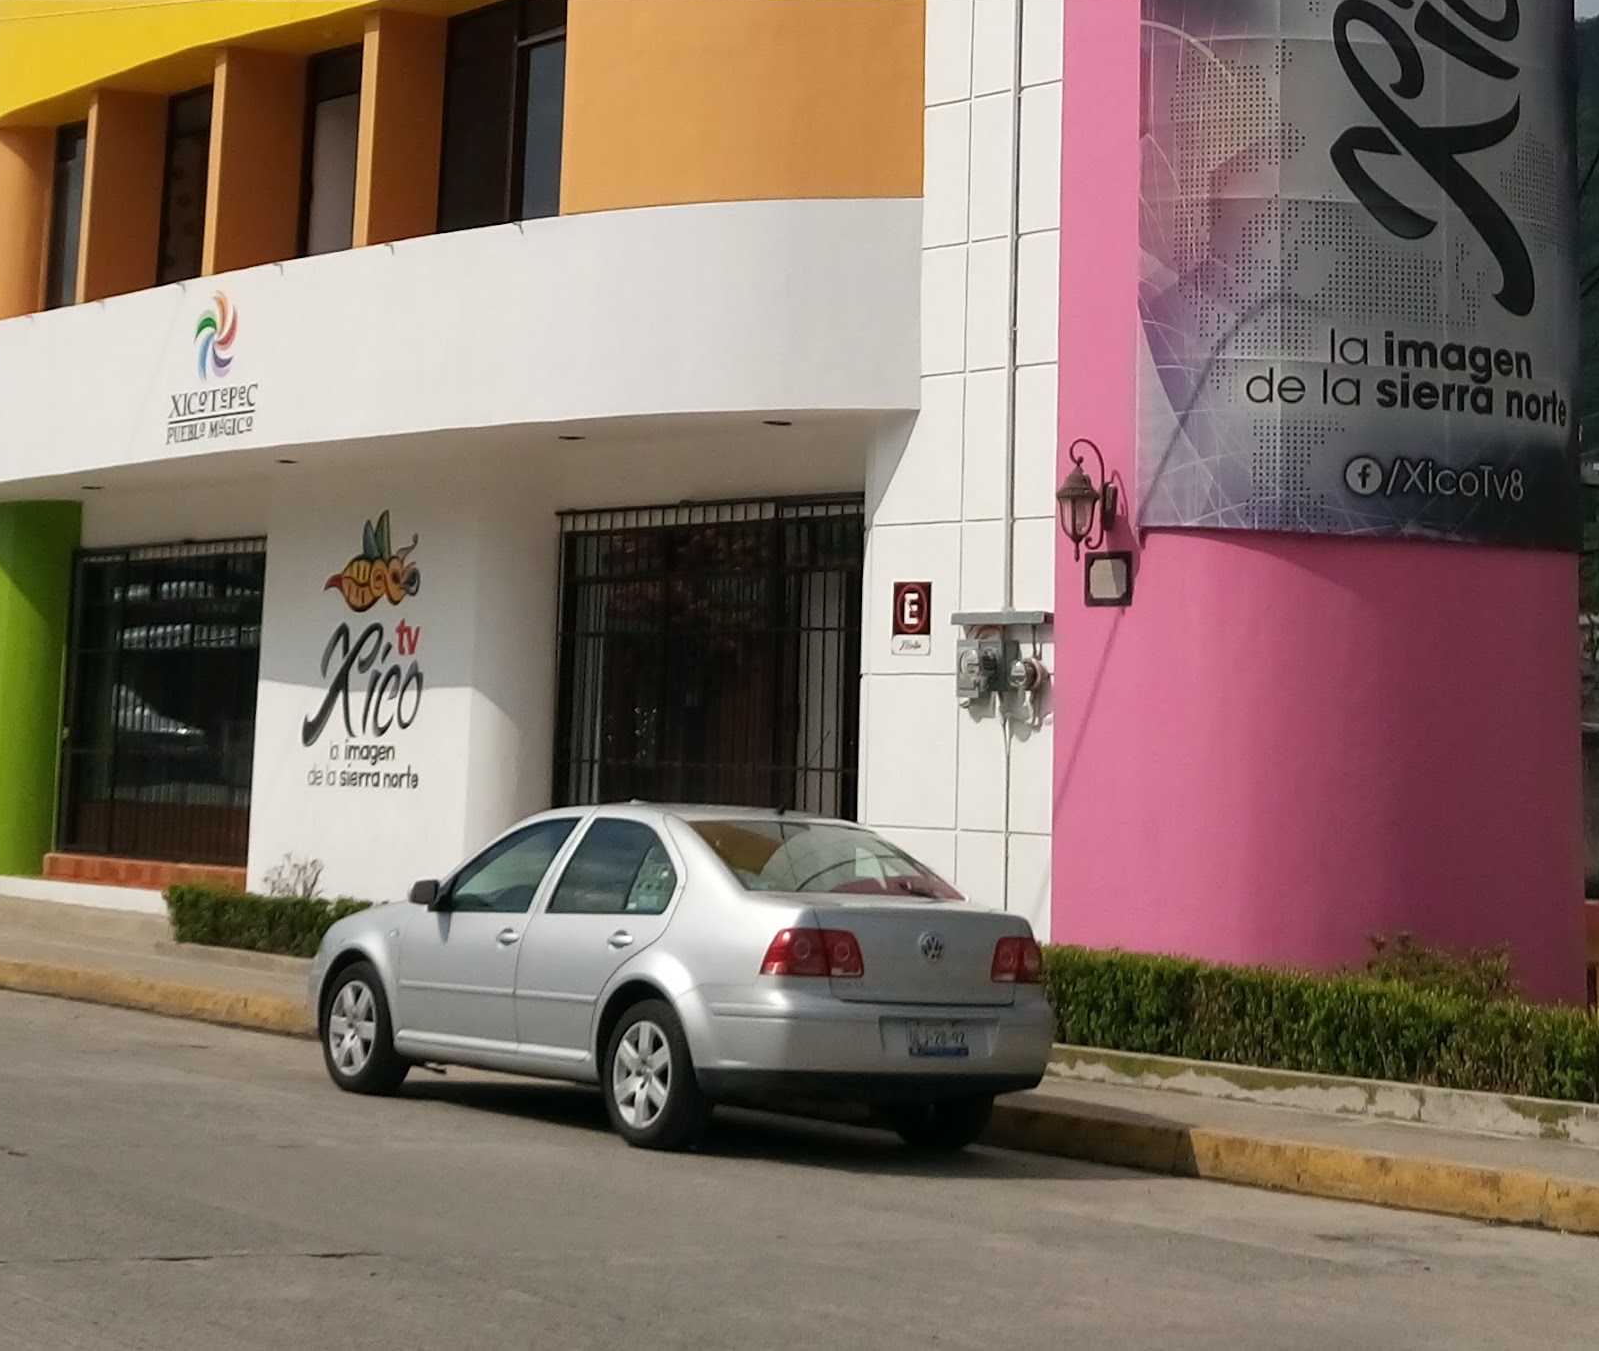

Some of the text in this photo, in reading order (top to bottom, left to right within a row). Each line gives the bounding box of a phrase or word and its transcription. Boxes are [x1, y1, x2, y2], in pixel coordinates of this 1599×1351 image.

[1330, 327, 1533, 385] la imagen
[1246, 366, 1567, 427] de la sierra norte
[903, 592, 920, 625] E
[395, 618, 421, 655] tv
[301, 622, 424, 748] Xico
[344, 737, 395, 766] imagen
[339, 764, 380, 788] sierra
[382, 764, 419, 790] norte
